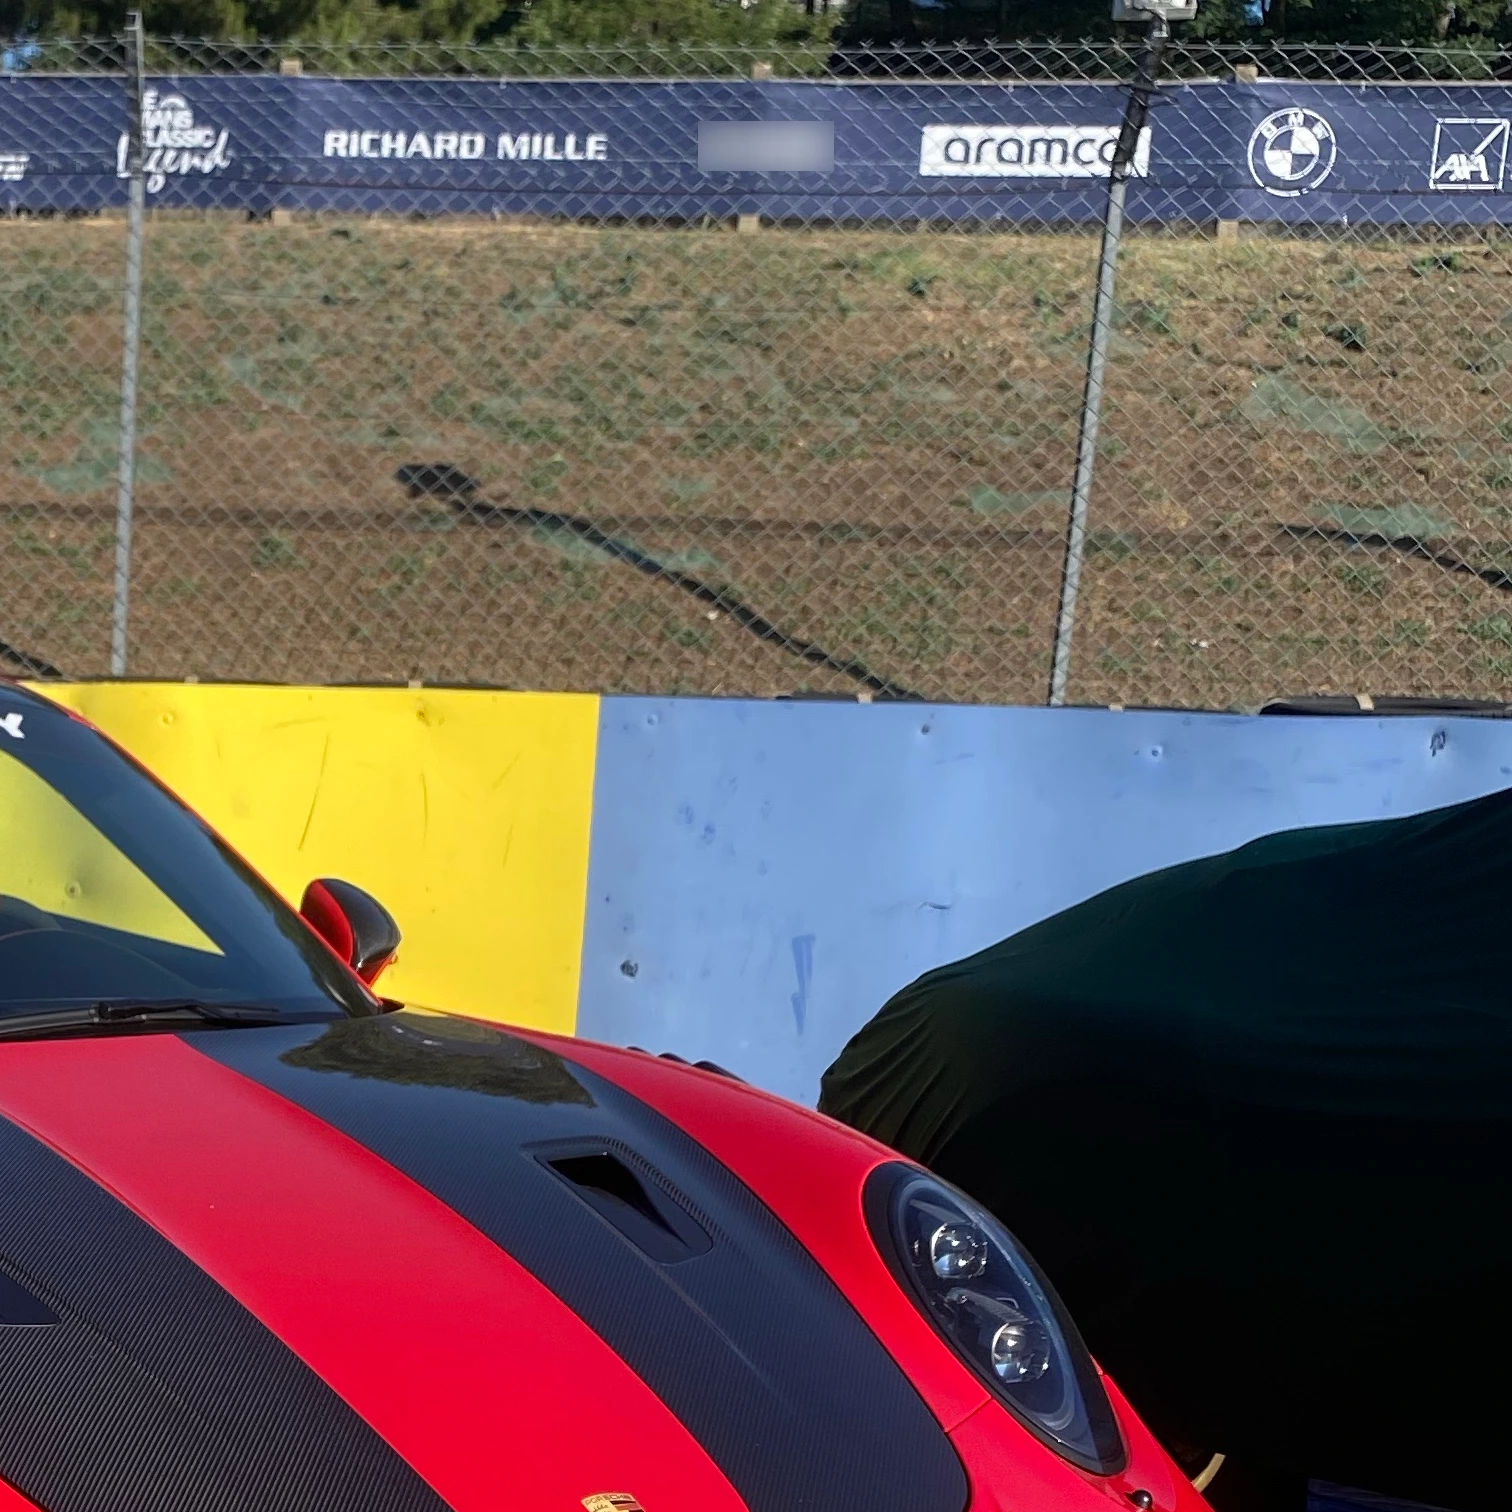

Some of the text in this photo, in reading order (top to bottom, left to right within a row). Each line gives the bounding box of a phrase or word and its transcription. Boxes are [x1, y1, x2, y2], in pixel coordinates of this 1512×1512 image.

[323, 130, 609, 162] RICHARD MILLE
[1433, 153, 1489, 182] AXA
